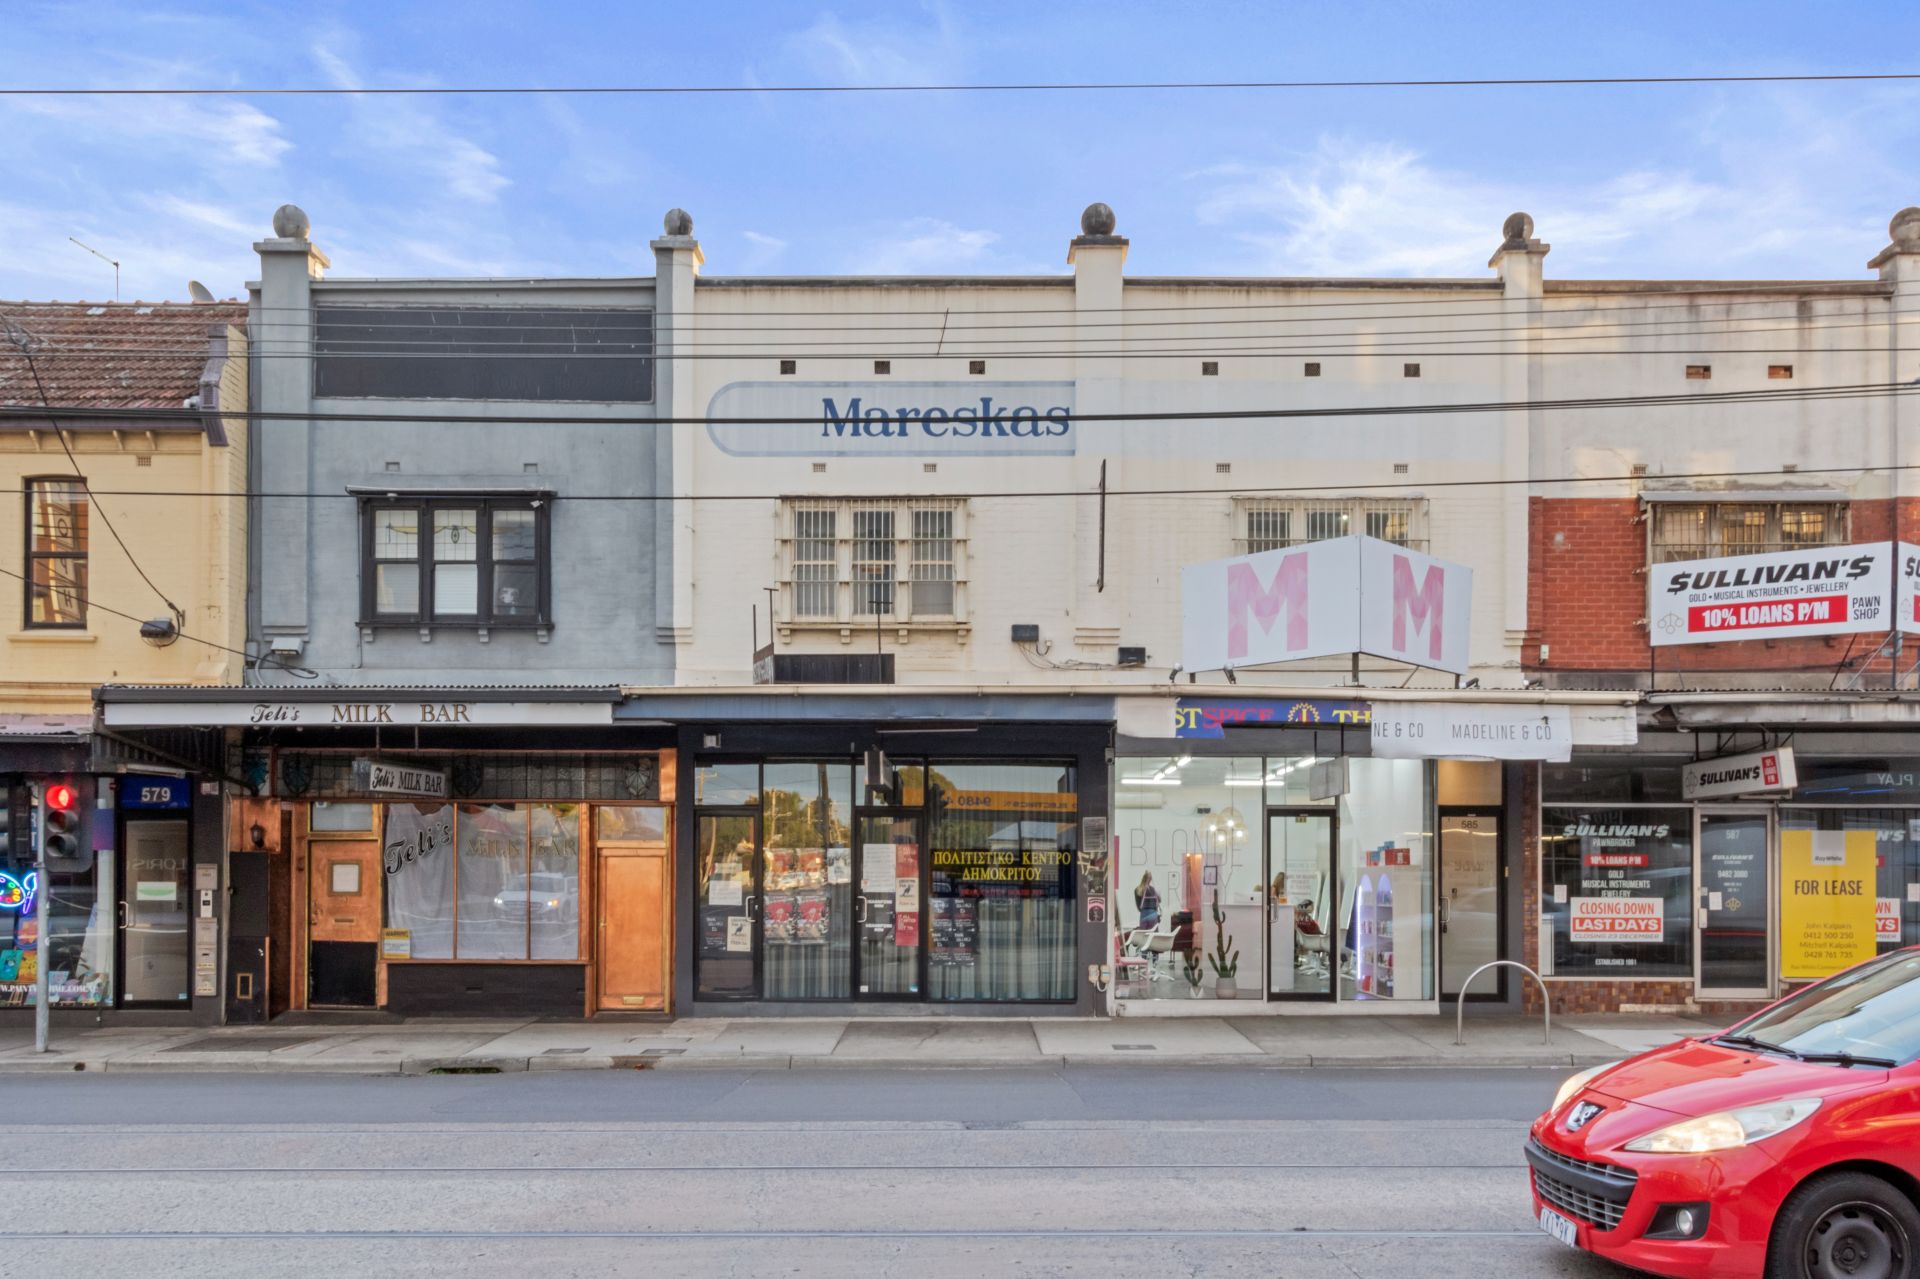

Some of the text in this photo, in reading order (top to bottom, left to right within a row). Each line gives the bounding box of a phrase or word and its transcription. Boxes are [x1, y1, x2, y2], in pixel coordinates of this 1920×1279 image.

[821, 397, 1071, 437] Mareskas
[1688, 581, 1849, 603] GOLD MUSICAL INSTRUMENTS JEWELLERY
[1227, 551, 1309, 659] M
[1392, 553, 1445, 661] M
[1852, 595, 1880, 608] PAWN
[1702, 602, 1829, 628] 10% LOANS P/M
[1853, 607, 1880, 620] SHOP
[331, 704, 394, 723] MILK
[420, 703, 471, 722] BAR
[1394, 722, 1402, 738] &
[1408, 723, 1424, 738] CO
[1451, 724, 1552, 740] MADELINE & CO
[398, 770, 421, 791] MILK
[424, 774, 442, 793] BAR
[141, 787, 171, 802] 579
[1461, 820, 1479, 829] 585
[1130, 828, 1244, 866] BLONDE
[1592, 838, 1636, 847] PAWNBROKER
[933, 851, 1015, 865] ΠΟΛΙΤΙΣΤΙΚΟ
[1021, 851, 1072, 865] ΚΕΝΤΡΟ
[1605, 856, 1626, 865] LOANS
[962, 867, 1042, 881] ΔΗΜΟΚΡΙΤΟΥ
[1607, 870, 1625, 879] GOLD
[1581, 880, 1651, 889] MUSICAL INSTRUMENTS
[1794, 880, 1863, 896] FOR LEASE
[1579, 902, 1655, 915] CLOSING DOWN
[1575, 918, 1659, 931] LAST DAYS
[1876, 919, 1896, 931] YS
